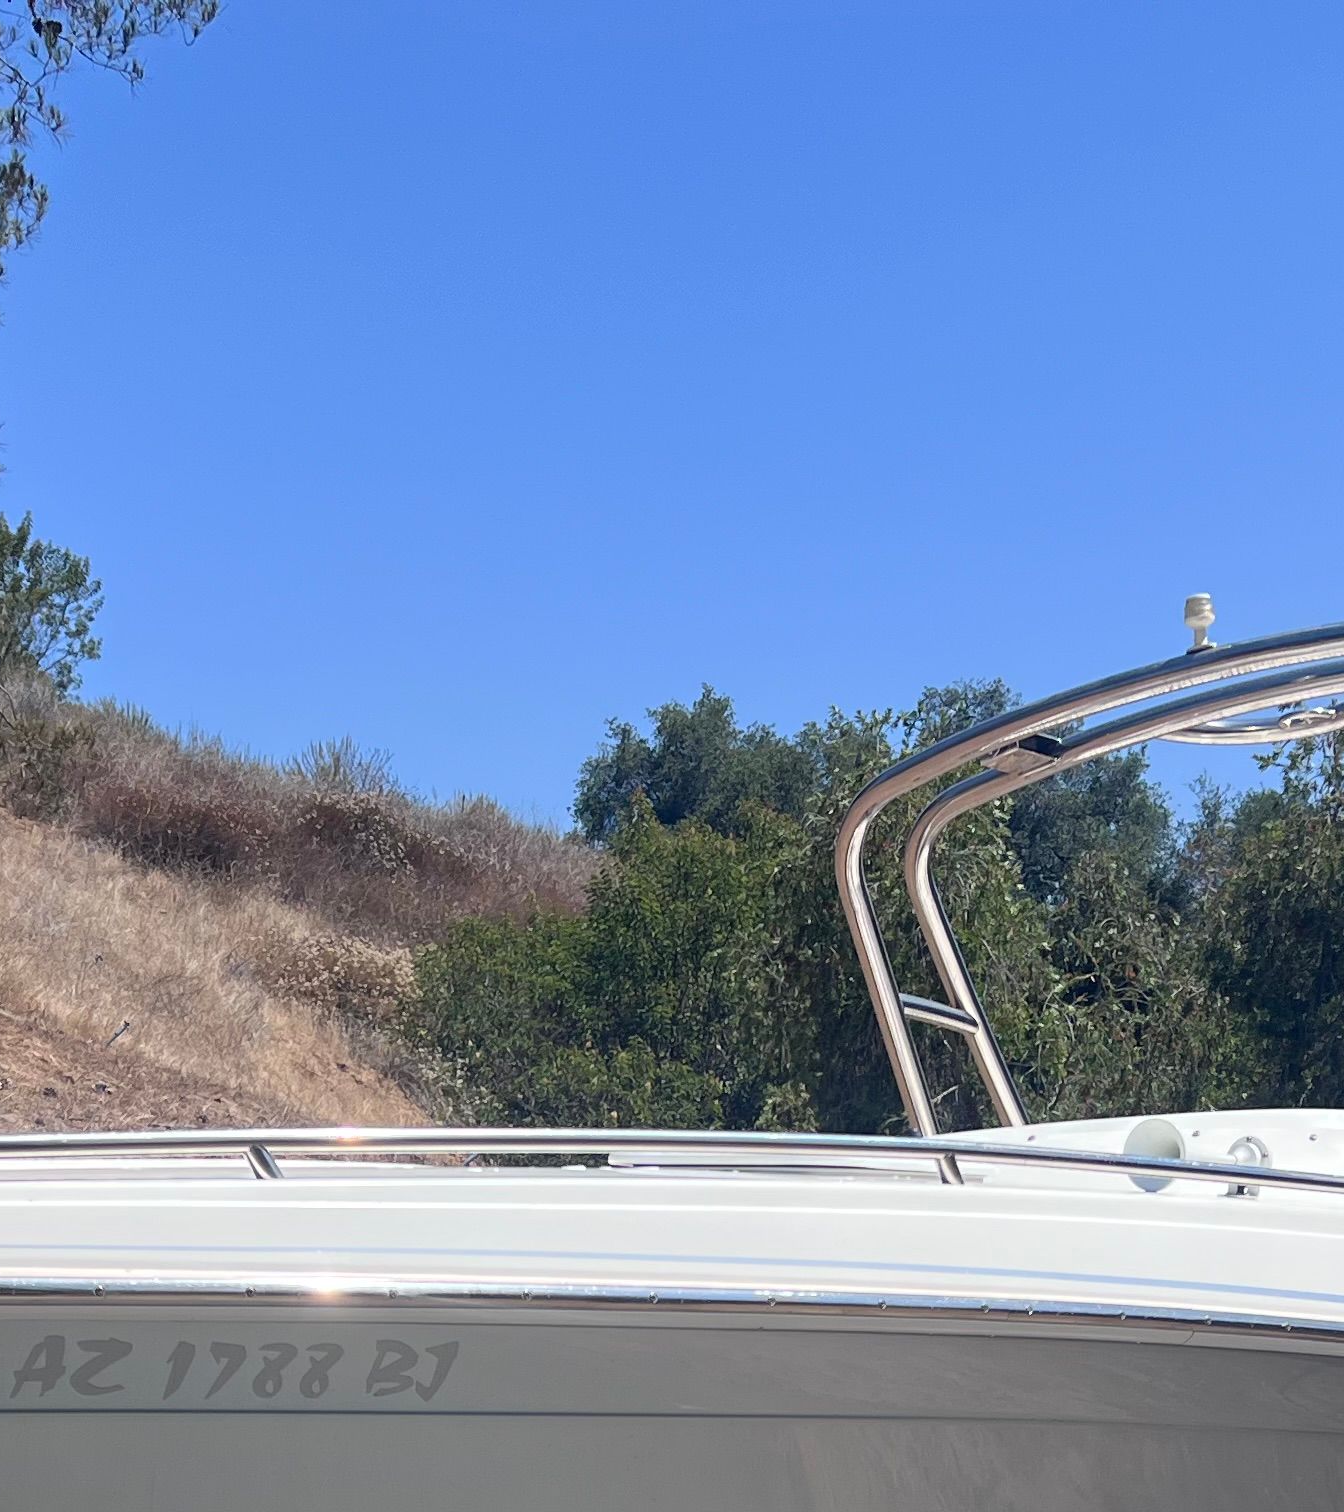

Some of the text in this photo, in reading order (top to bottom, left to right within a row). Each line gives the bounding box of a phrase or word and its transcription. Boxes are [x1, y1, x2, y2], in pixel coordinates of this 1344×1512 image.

[9, 1335, 459, 1401] AZ 1788 BJ
